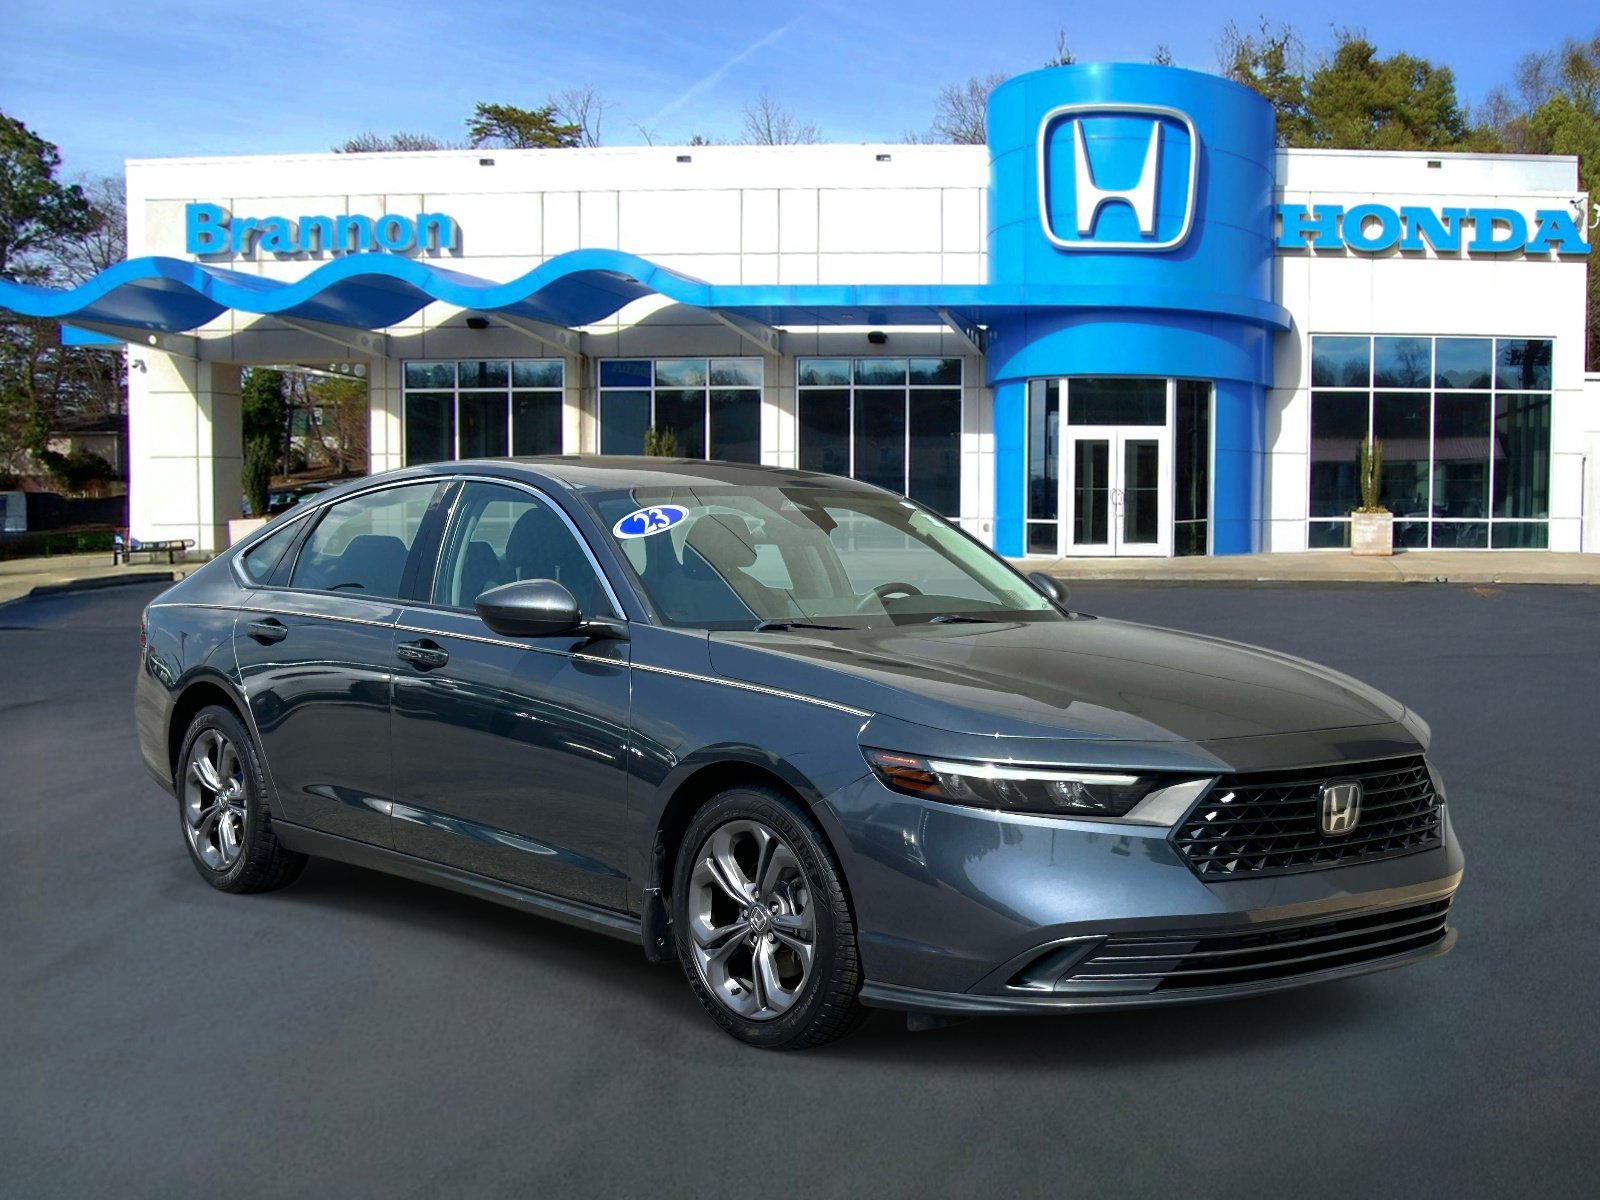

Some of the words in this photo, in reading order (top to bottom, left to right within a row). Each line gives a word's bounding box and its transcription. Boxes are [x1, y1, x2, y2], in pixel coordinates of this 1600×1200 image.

[185, 202, 455, 256] Brannon
[1278, 204, 1592, 255] HONDA
[634, 508, 671, 534] 23
